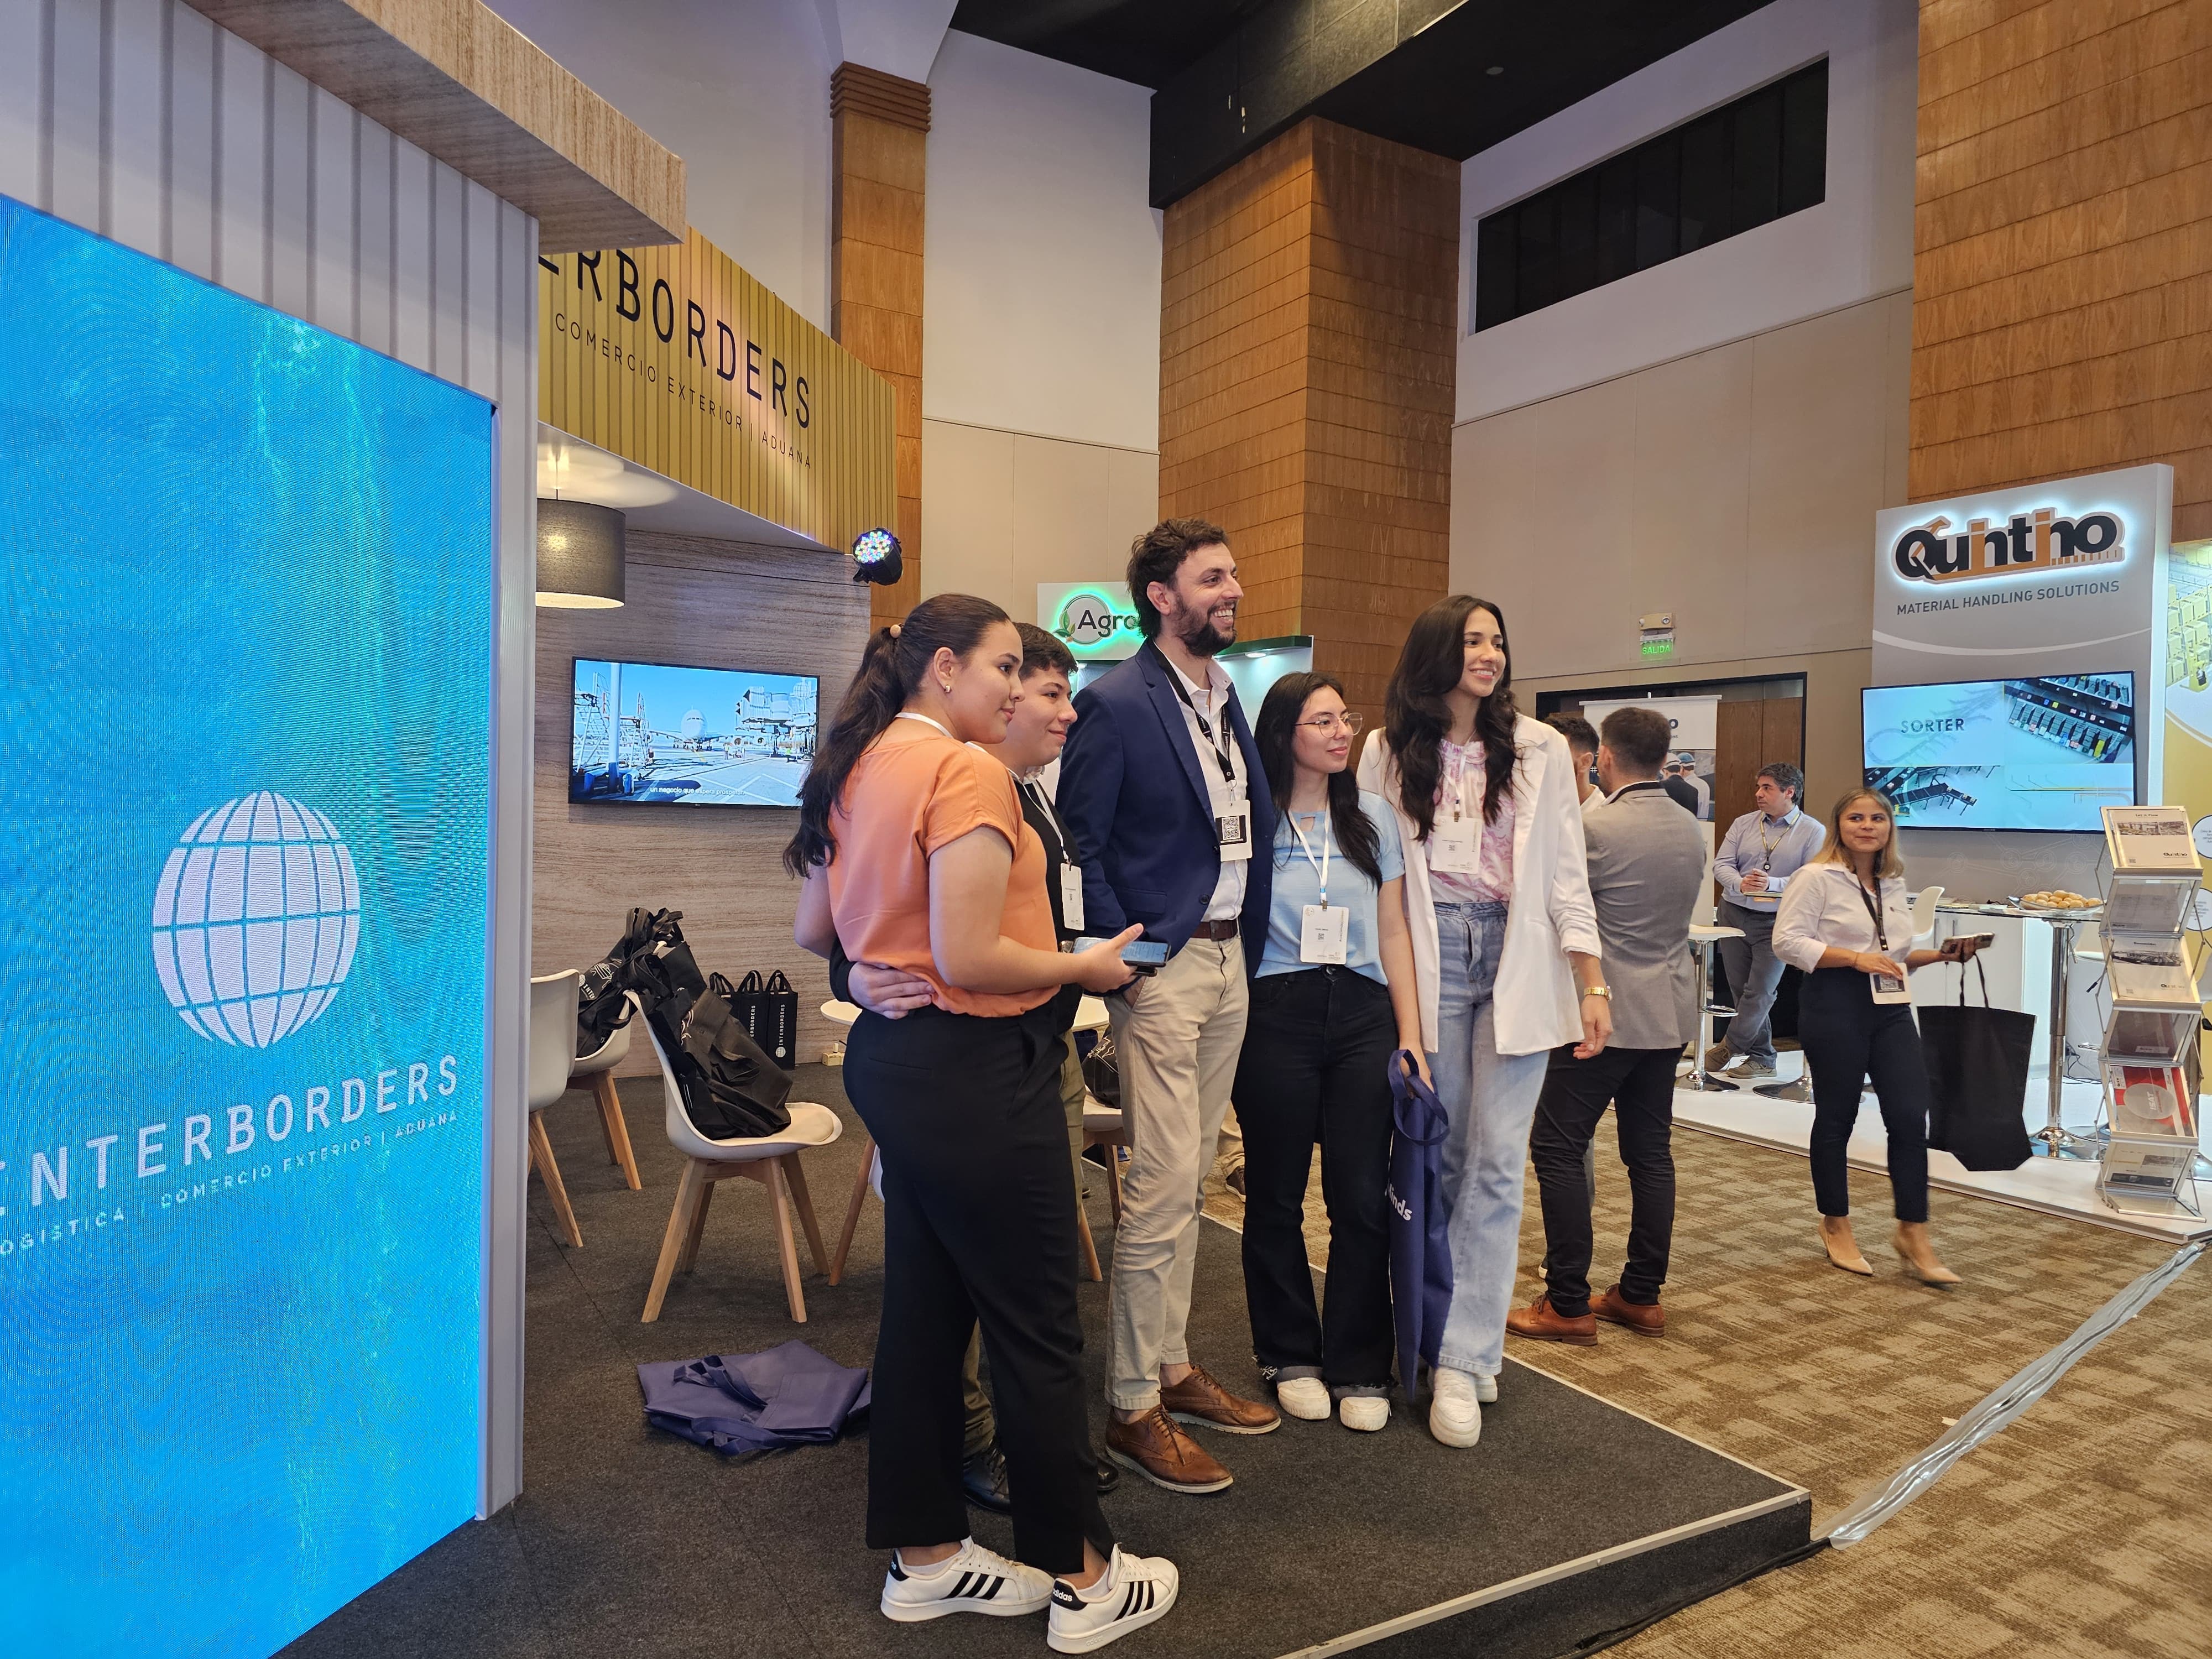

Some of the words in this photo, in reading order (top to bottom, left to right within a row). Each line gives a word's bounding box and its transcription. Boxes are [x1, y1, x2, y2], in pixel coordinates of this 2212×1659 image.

[539, 249, 810, 429] RBORDERS
[555, 313, 656, 383] COMERCIO
[668, 376, 742, 432] EXTERIOR
[761, 431, 811, 469] ADUANA
[1895, 511, 2117, 579] Quintino
[1897, 598, 1958, 615] MATERIAL
[1963, 589, 2033, 607] HANDLING
[2037, 580, 2120, 599] SOLUTIONS
[1642, 645, 1671, 655] SALIDA
[1901, 718, 1965, 733] SORTER
[0, 1054, 457, 1215] NTERBORDERS
[161, 1164, 272, 1208] COMERCIO
